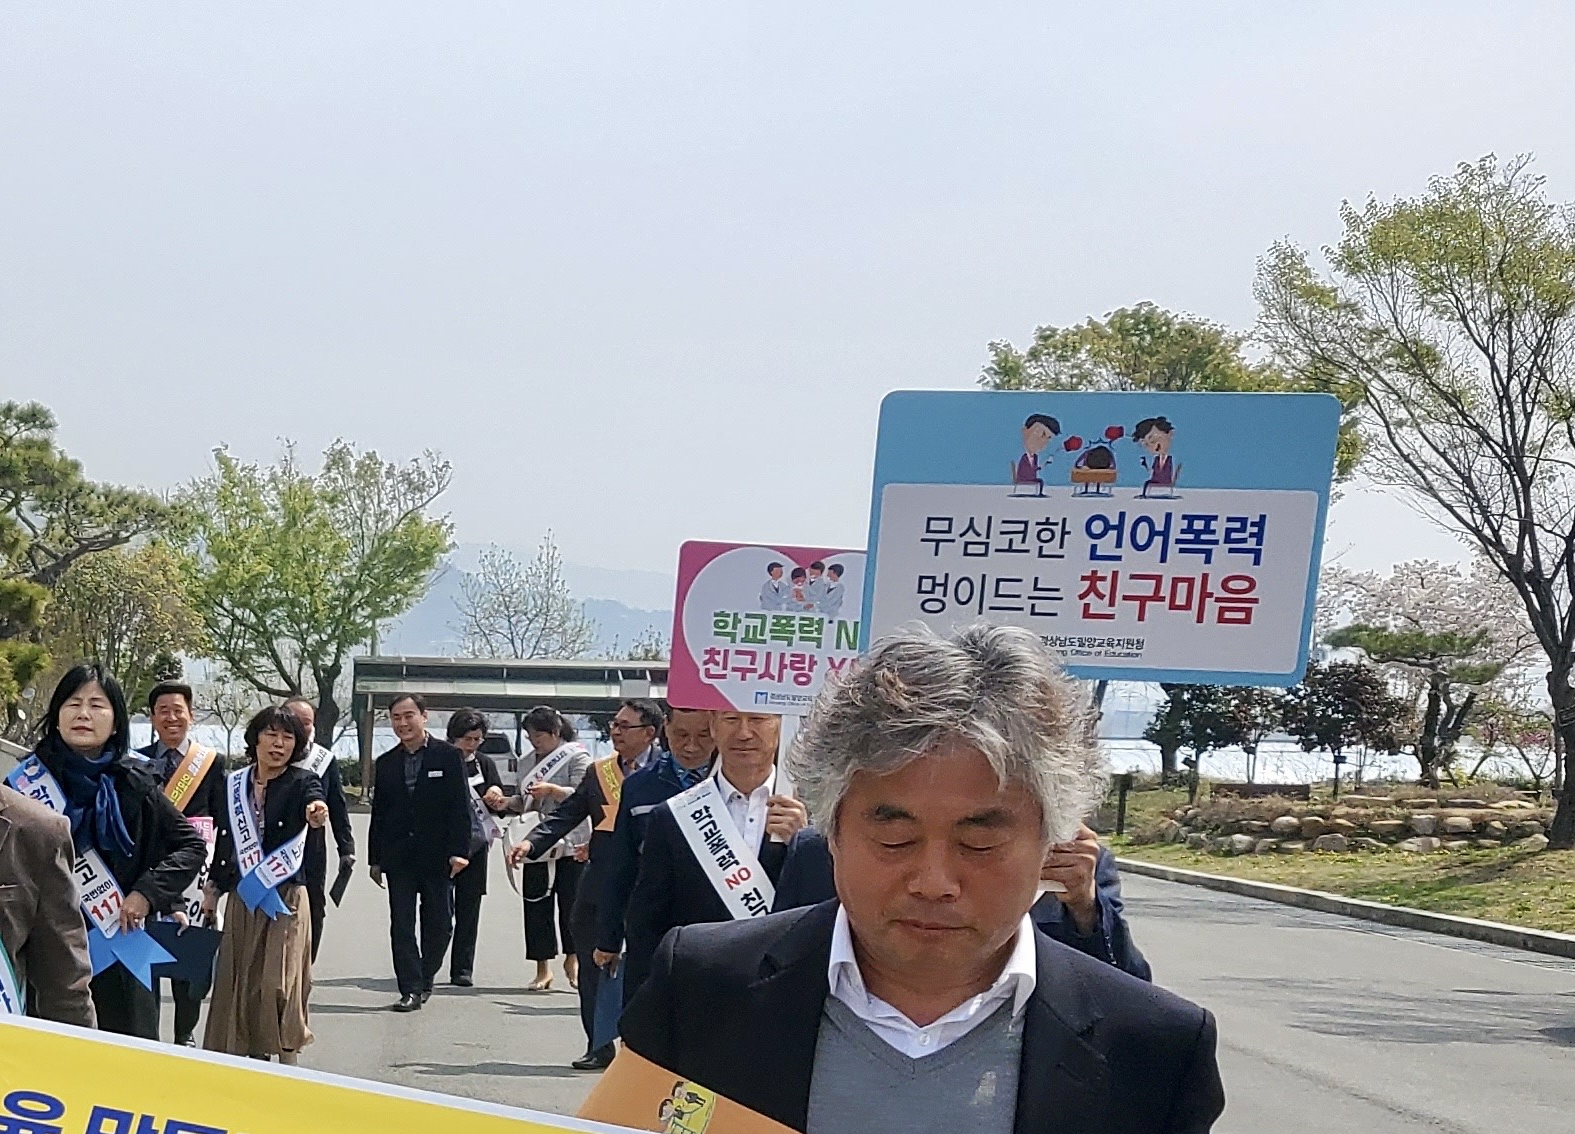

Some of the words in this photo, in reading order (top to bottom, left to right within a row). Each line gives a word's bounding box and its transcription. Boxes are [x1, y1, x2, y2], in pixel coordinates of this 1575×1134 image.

[920, 515, 1072, 559] 무심코한
[1084, 511, 1267, 567] 언어폭력
[917, 573, 1064, 617] 멍이드는
[1077, 569, 1260, 625] 친구마음
[713, 610, 824, 649] 학교폭력
[702, 647, 818, 686] 친구사랑
[241, 850, 262, 869] 117
[266, 855, 288, 878] 117
[690, 804, 740, 871] 학교폭력
[725, 867, 752, 890] NO
[82, 879, 114, 902] 국번없이
[91, 891, 122, 922] 117
